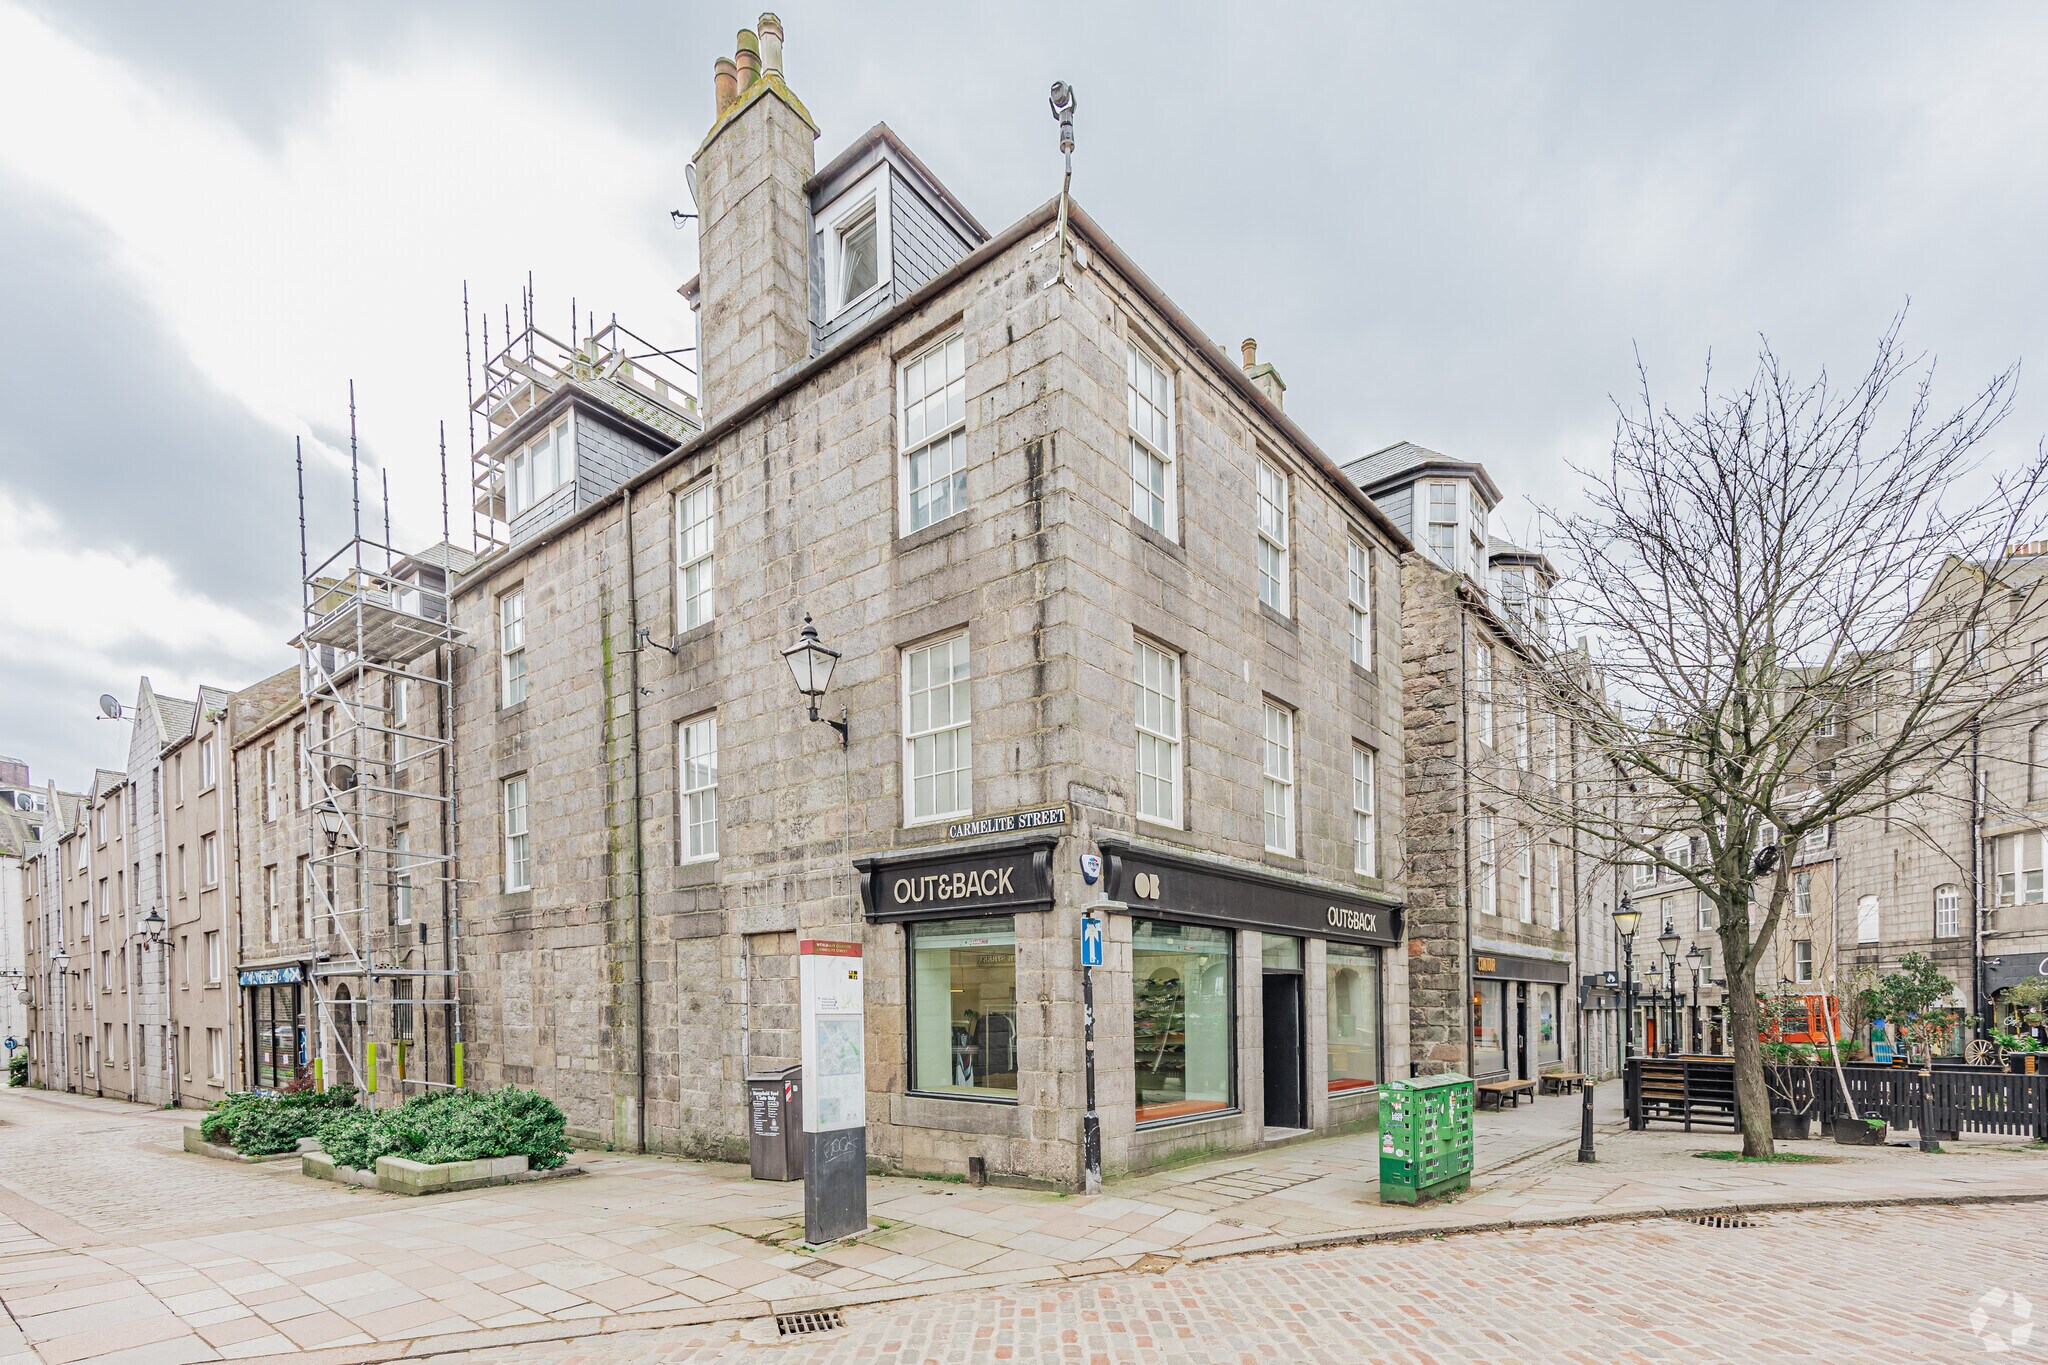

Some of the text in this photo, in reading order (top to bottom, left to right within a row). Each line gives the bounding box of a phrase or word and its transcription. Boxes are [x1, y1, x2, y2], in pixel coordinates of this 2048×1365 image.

[949, 808, 1066, 839] CARMELITE STREET
[894, 867, 1014, 903] OUT&BACK
[1327, 906, 1377, 933] OUT&BACK
